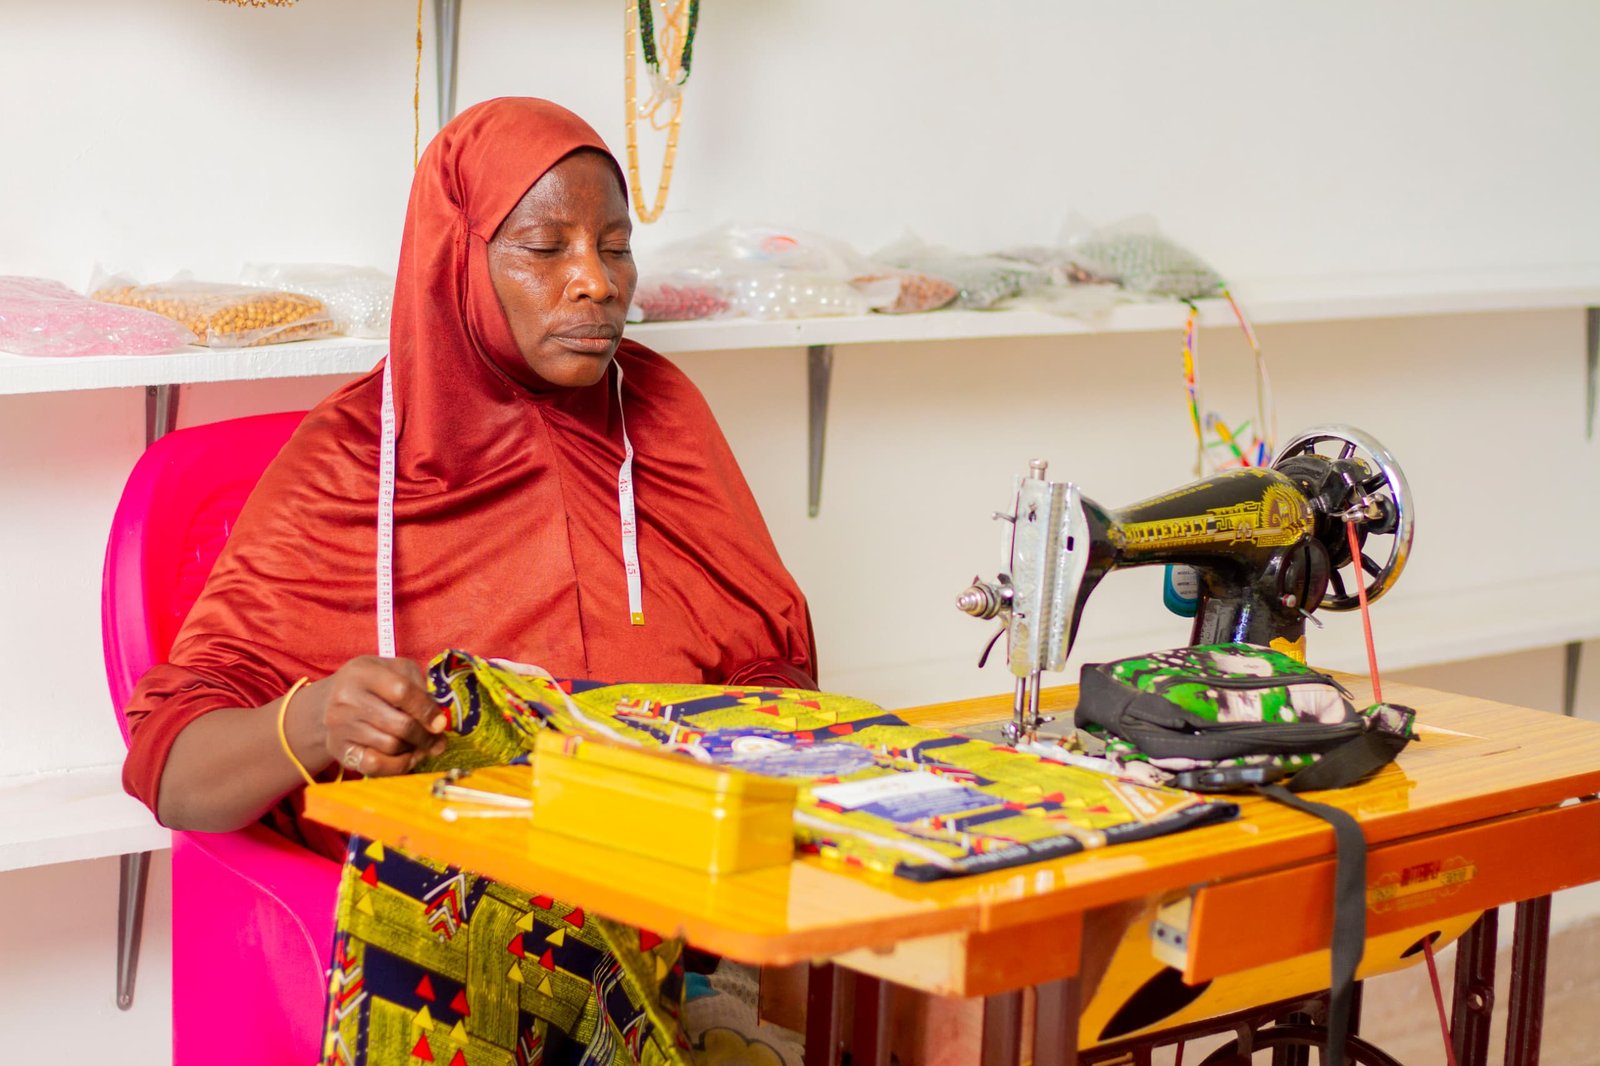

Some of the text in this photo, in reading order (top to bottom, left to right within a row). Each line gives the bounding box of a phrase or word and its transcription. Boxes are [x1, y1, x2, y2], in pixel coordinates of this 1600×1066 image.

[619, 478, 628, 492] 43
[623, 520, 632, 535] 44
[1125, 518, 1208, 542] BUTTERFLY
[626, 561, 636, 575] 45
